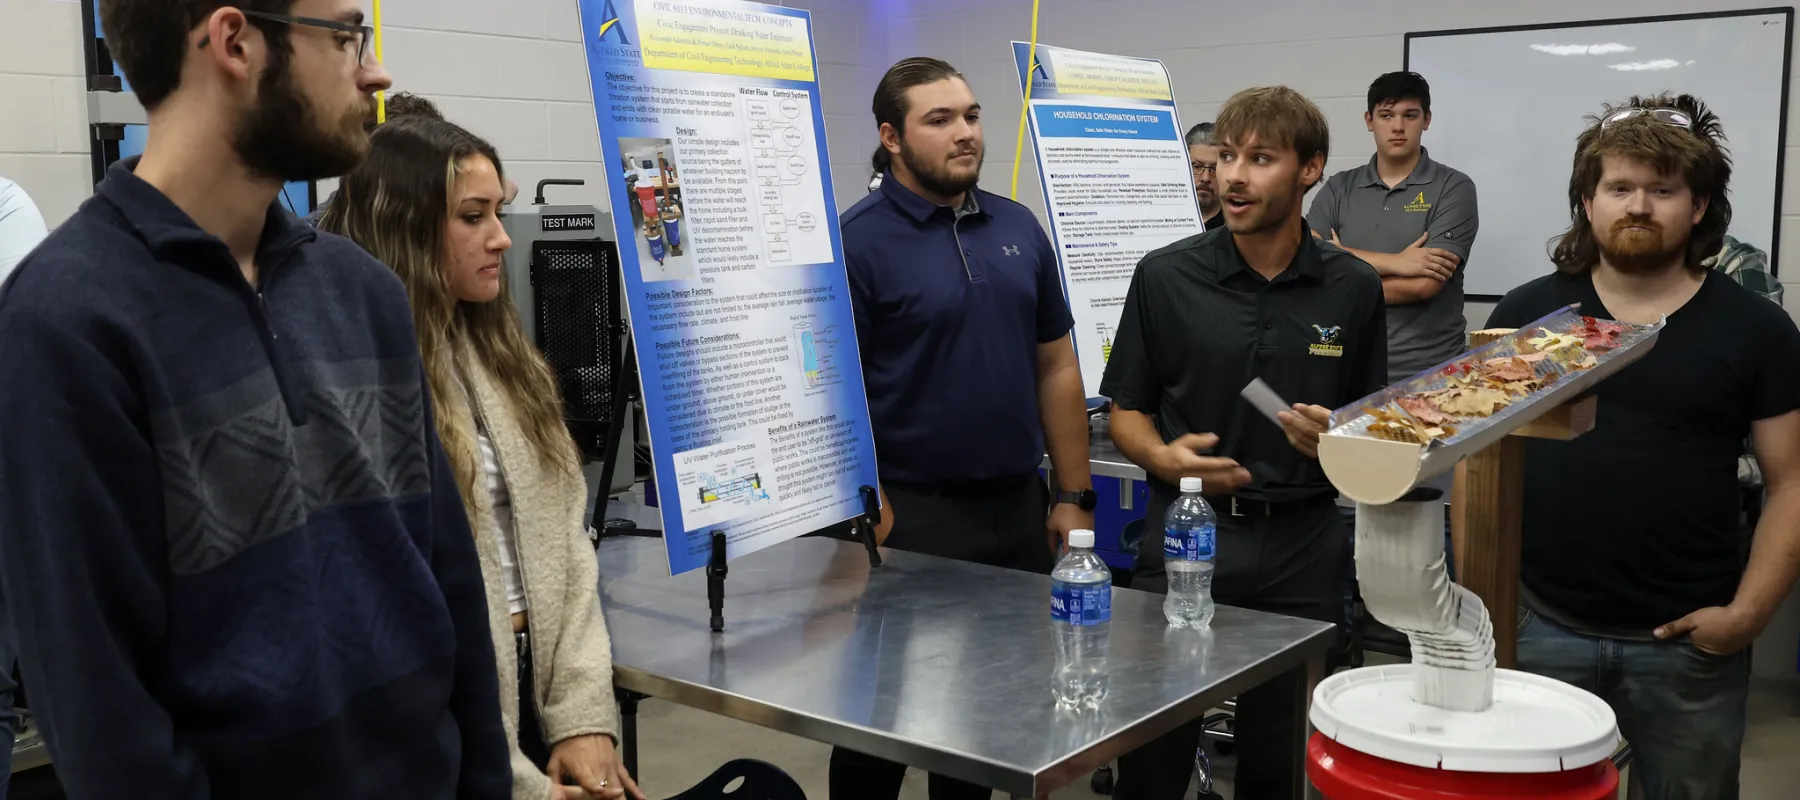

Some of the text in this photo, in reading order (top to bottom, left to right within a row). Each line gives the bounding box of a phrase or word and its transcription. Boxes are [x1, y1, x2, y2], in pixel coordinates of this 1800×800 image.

[620, 47, 641, 58] STATE
[606, 82, 618, 90] The
[618, 83, 643, 93] objective
[660, 86, 678, 96] project
[738, 87, 755, 95] Water
[608, 92, 630, 101] filtration
[630, 94, 650, 104] system
[687, 98, 710, 106] rainwater
[710, 99, 732, 107] collection
[790, 91, 808, 100] System
[662, 106, 681, 116] potable
[1054, 111, 1158, 123] HOUSEHOLD CHLORINATION SYSTEM
[687, 137, 704, 146] simple
[704, 138, 720, 146] design
[687, 147, 706, 156] primary
[697, 157, 711, 166] being
[736, 177, 748, 185] point
[543, 218, 593, 227] TEST MARK
[695, 245, 717, 253] standard
[731, 244, 747, 253] system
[699, 266, 720, 275] pressure
[645, 290, 670, 300] Possible
[670, 288, 691, 300] Design
[655, 339, 680, 350] Possible
[680, 336, 699, 346] Future
[767, 423, 787, 435] Benefits
[797, 416, 819, 428] Rainwater
[819, 412, 836, 424] System
[684, 441, 756, 464] UV Water Purification Process
